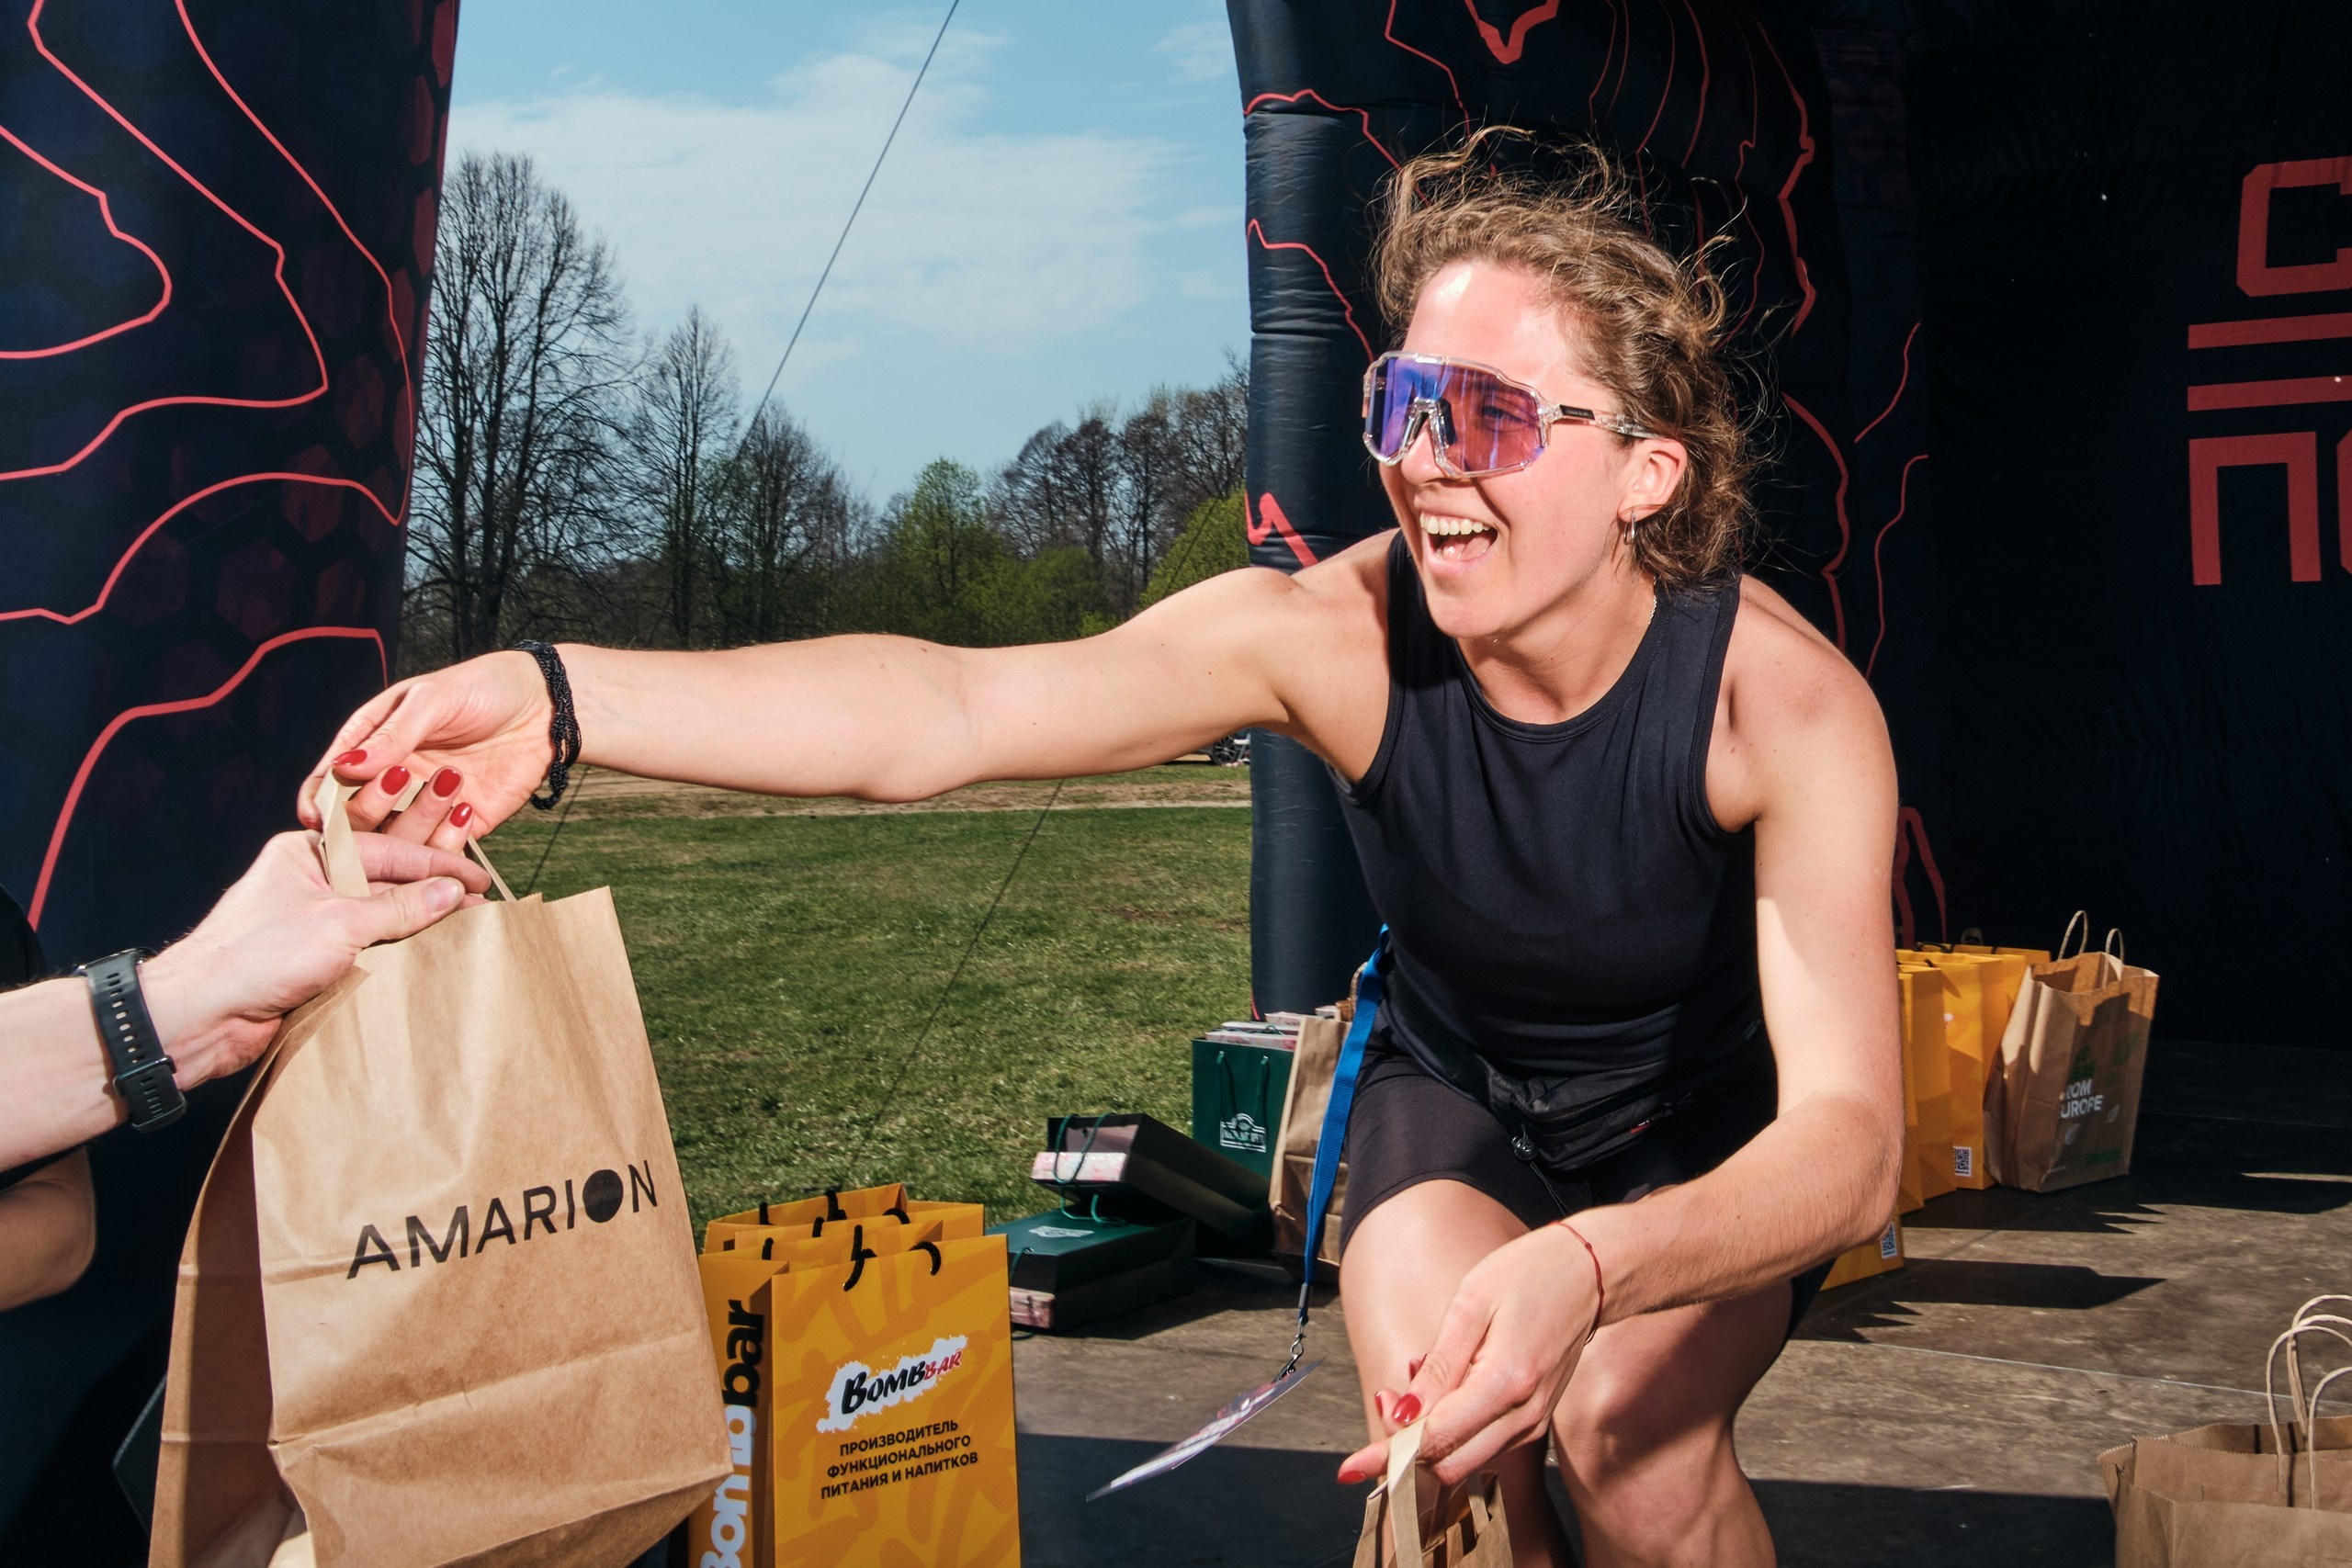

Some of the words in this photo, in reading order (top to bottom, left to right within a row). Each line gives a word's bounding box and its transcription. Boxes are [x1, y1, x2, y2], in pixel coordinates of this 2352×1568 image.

[2058, 1095, 2103, 1119] UROPE
[2065, 1078, 2092, 1100] ROM
[346, 1160, 658, 1280] AMARION
[827, 1434, 971, 1478] ФУНКЦИОНАЛЬНОГО
[840, 1419, 958, 1457] ПРОИЗВОДИТЕЛЬ
[820, 1472, 888, 1499] ПИТАНИЯ
[892, 1469, 902, 1483] И
[905, 1451, 978, 1480] НАПИТКОВ
